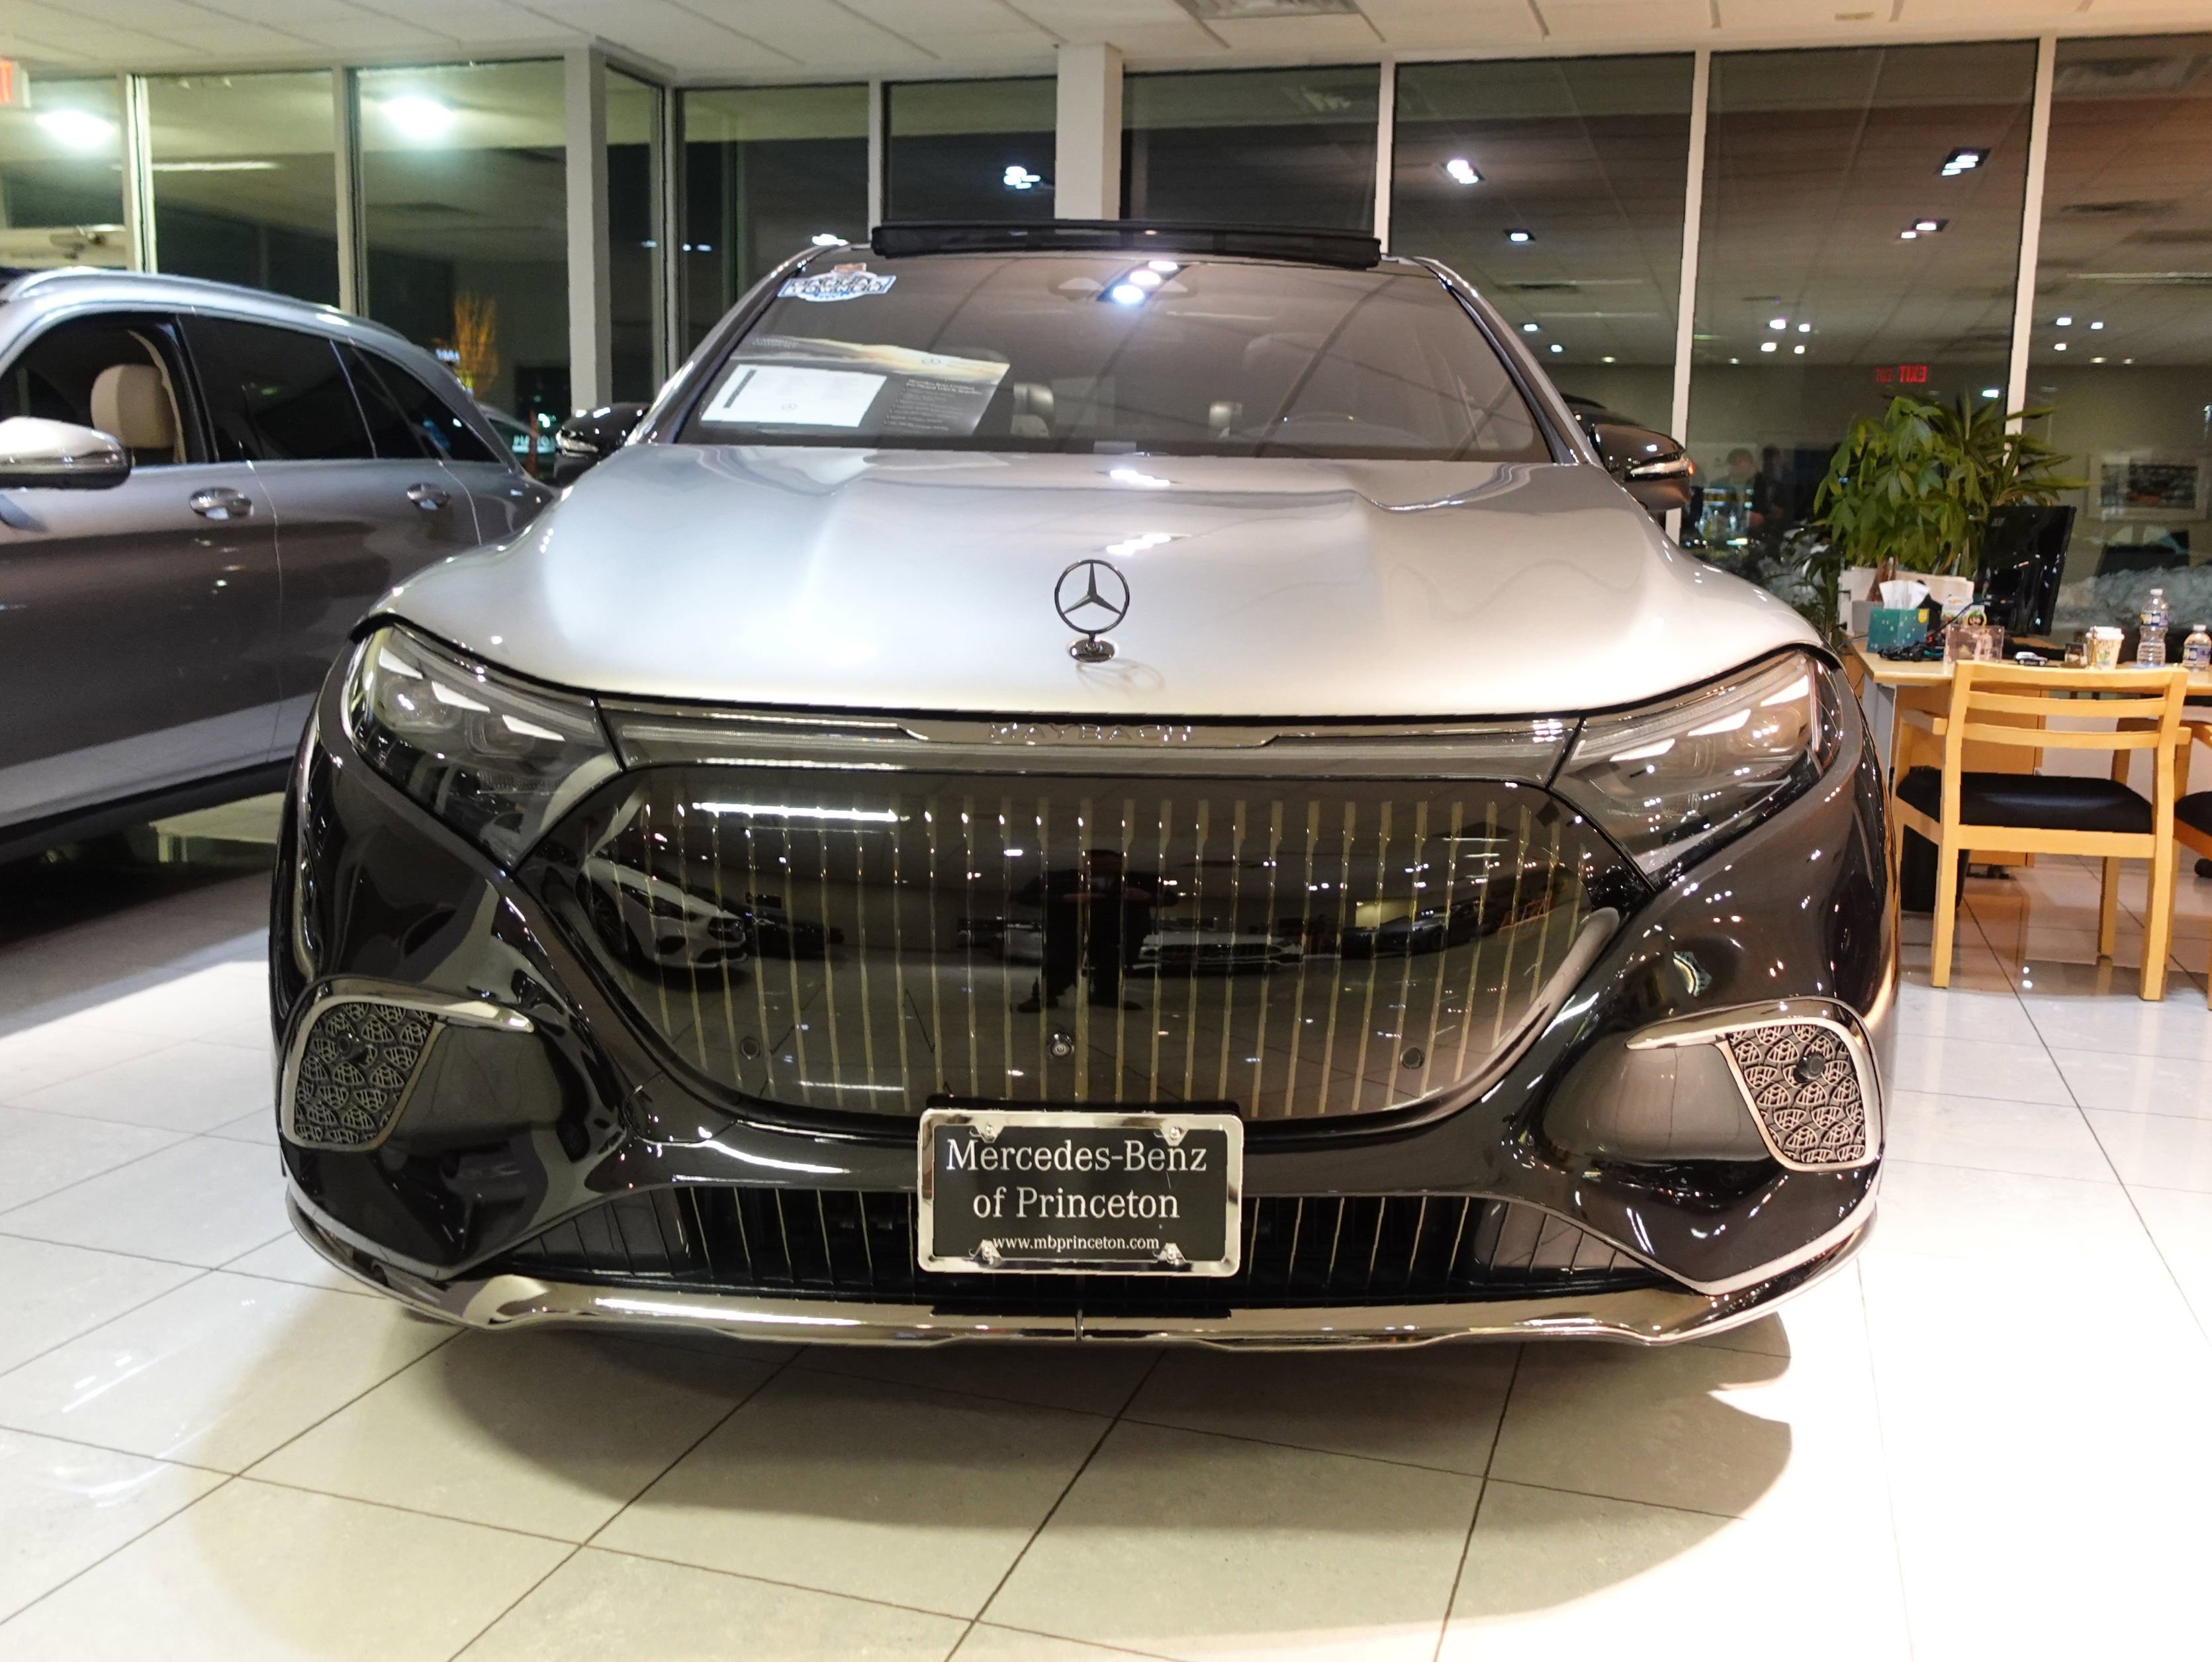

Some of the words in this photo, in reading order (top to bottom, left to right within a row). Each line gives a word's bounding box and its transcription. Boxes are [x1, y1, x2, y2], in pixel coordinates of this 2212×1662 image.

[989, 721, 1191, 741] MAYBACH
[946, 1138, 1207, 1172] Mercedes-Benz
[973, 1186, 1007, 1218] of
[1016, 1186, 1180, 1219] Princeton
[993, 1234, 1160, 1253] www.mbprinceton.com
